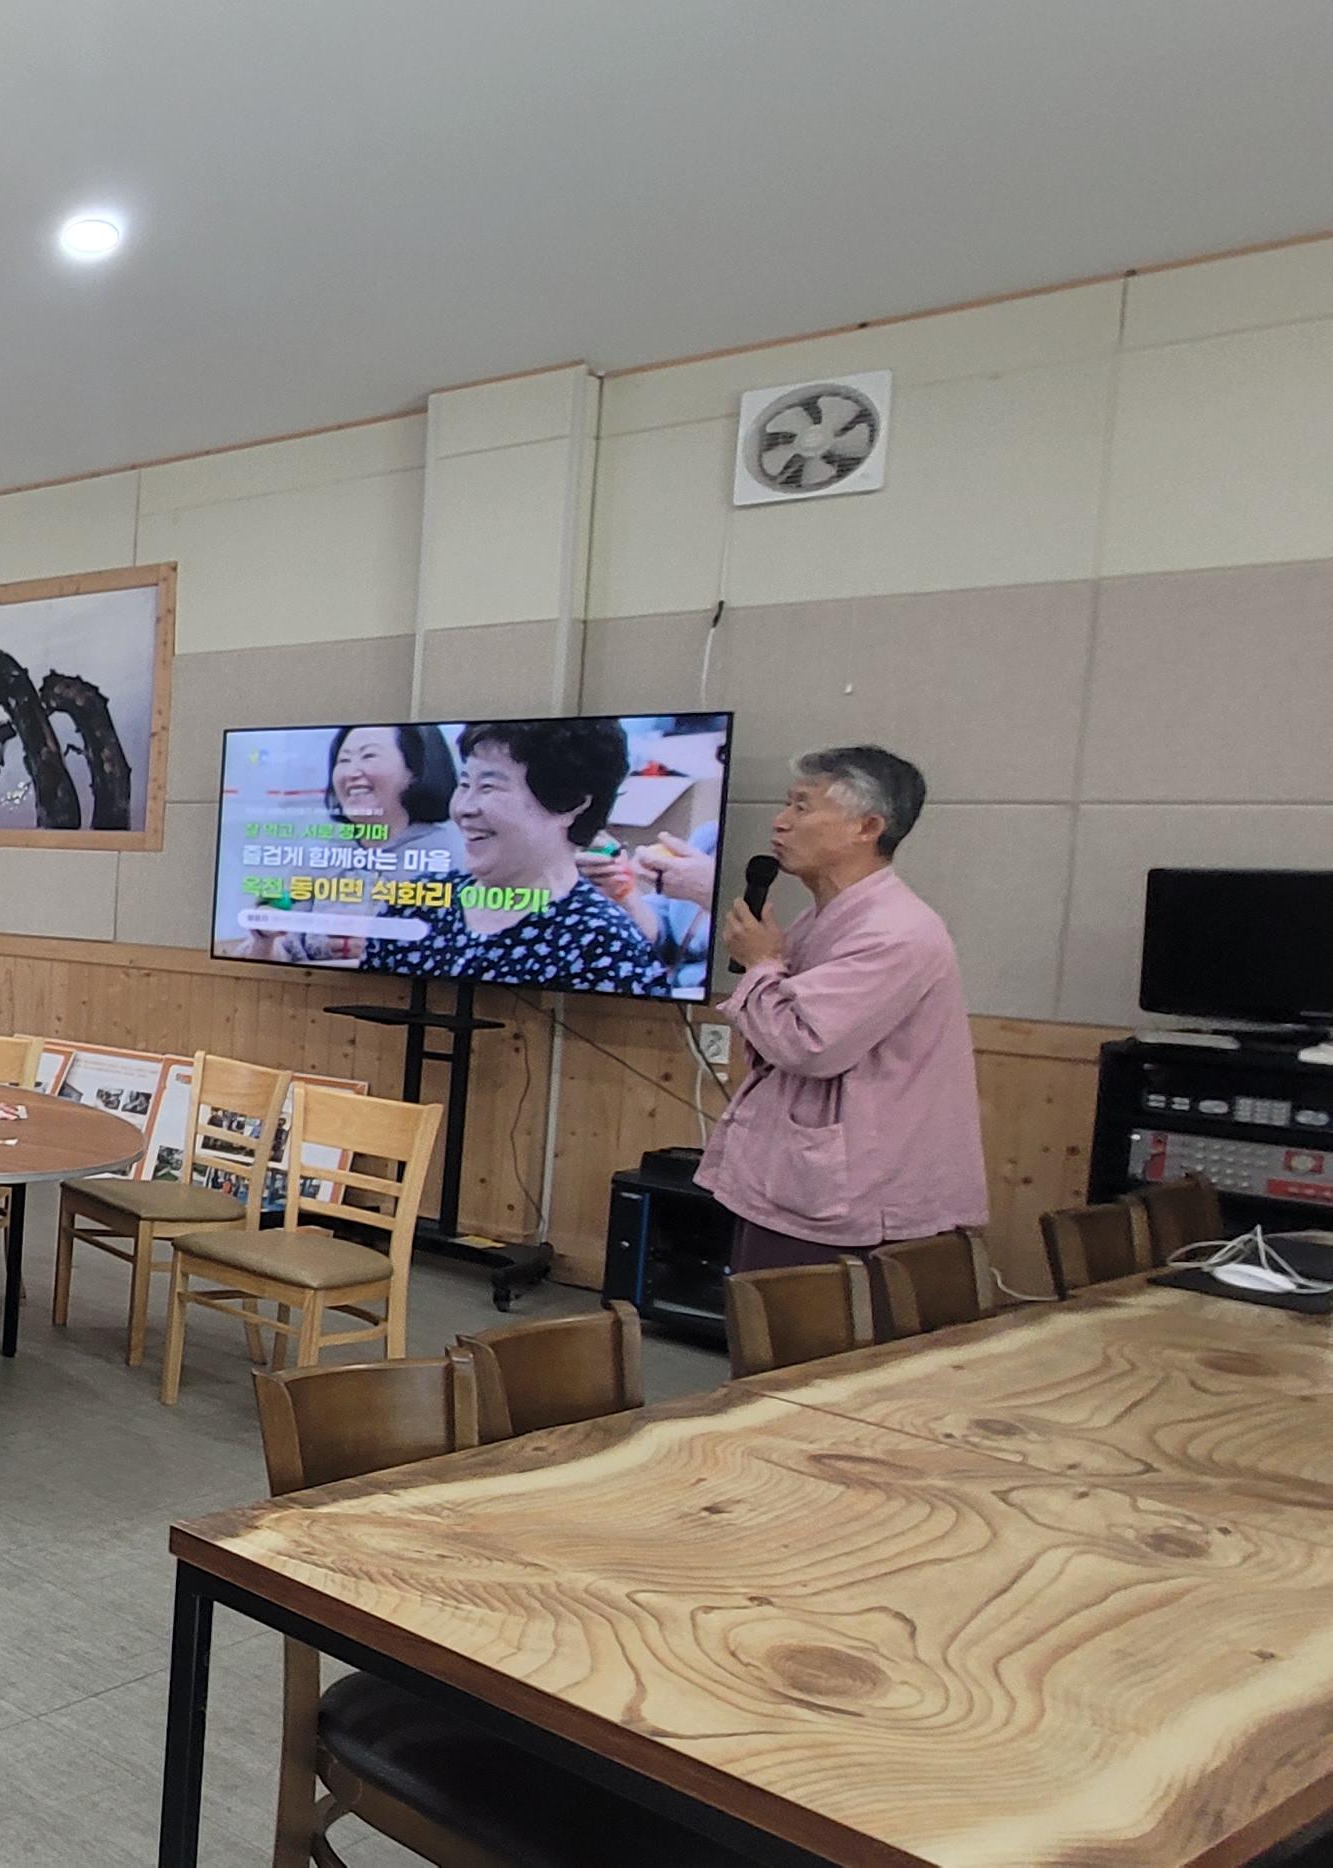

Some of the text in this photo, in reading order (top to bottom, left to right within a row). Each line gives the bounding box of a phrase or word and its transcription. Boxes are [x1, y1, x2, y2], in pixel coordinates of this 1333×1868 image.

[303, 823, 334, 841] 서로
[242, 844, 452, 873] 즐겁게 함께하는 마을
[241, 875, 551, 913] 옥천 동이면 석화리 이야기!
